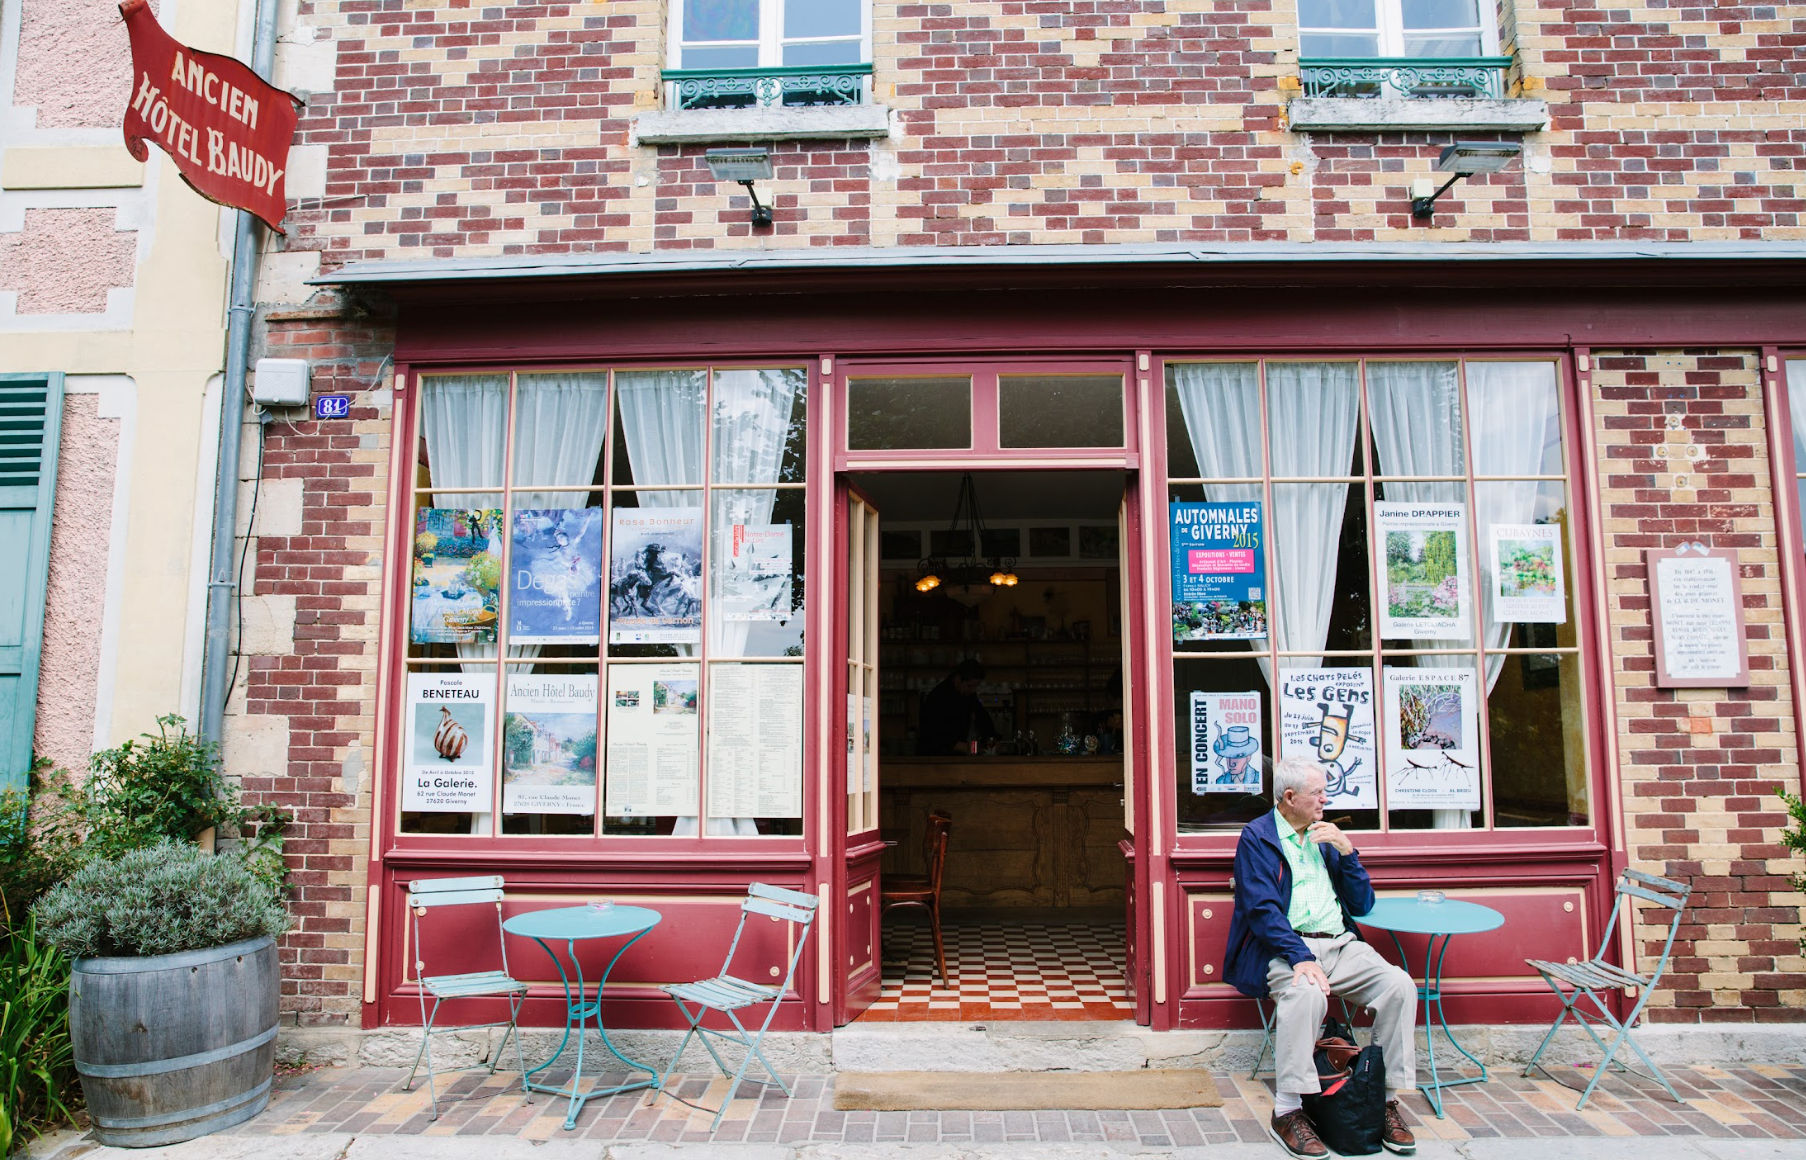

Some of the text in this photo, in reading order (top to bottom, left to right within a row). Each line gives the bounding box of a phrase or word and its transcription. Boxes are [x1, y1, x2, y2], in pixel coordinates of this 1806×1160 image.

[171, 51, 259, 130] ANCIEN
[131, 71, 285, 197] HÔTEL BAUDY
[323, 399, 341, 414] 81
[1175, 508, 1258, 524] AUTOMNALES
[1379, 510, 1409, 518] Janine
[619, 518, 645, 526] Rosa
[1191, 524, 1248, 540] GIVERNY
[1233, 532, 1259, 549] 2015
[1183, 575, 1187, 583] 3
[1198, 574, 1204, 583] 4
[1458, 673, 1470, 682] 87
[422, 689, 480, 699] BENETEAU
[510, 683, 595, 702] Ancien Hôtel Baudy
[1219, 698, 1257, 710] MANO
[1225, 712, 1257, 724] SOLO
[1194, 699, 1208, 763] CONCERT
[417, 777, 478, 788] La Galerie.
[1196, 768, 1208, 785] EN
